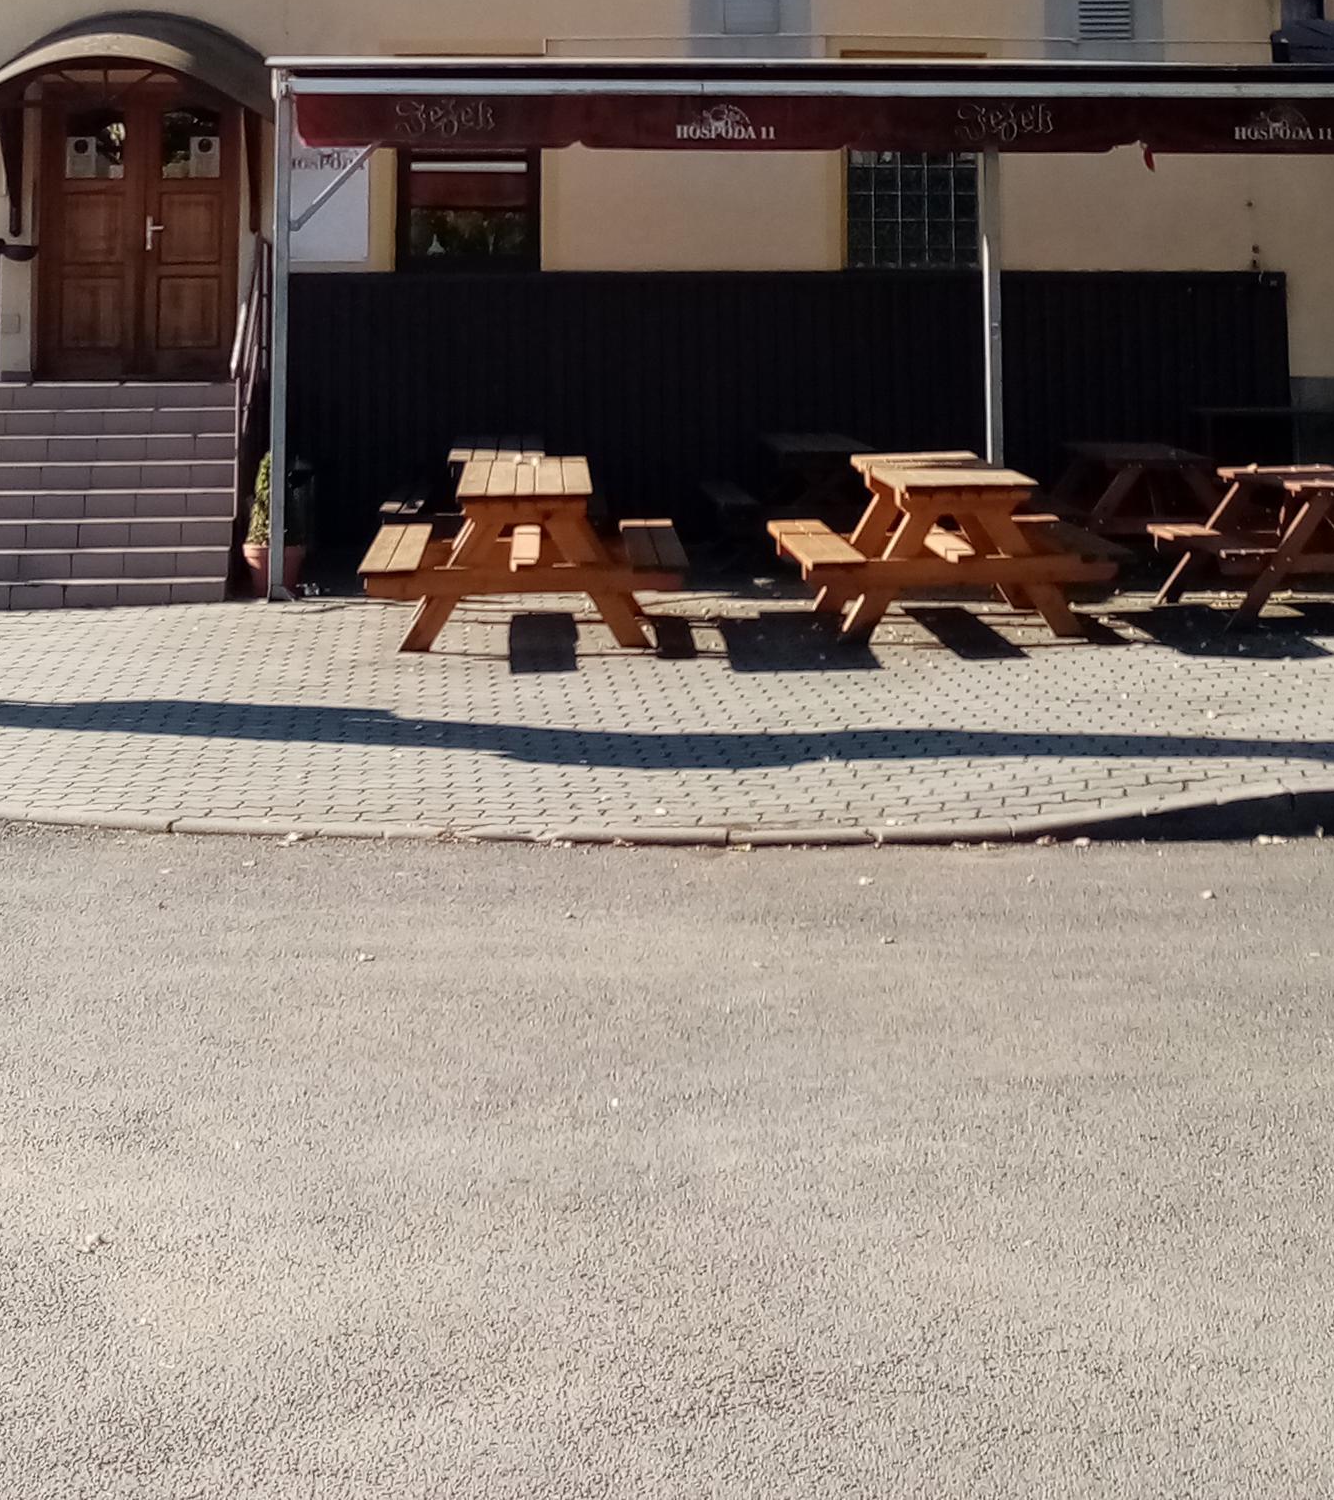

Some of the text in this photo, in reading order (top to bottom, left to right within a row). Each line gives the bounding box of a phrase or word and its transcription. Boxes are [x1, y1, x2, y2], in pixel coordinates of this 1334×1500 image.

[675, 122, 776, 140] HOSPODA 11
[1233, 123, 1333, 141] HOSPODA 11
